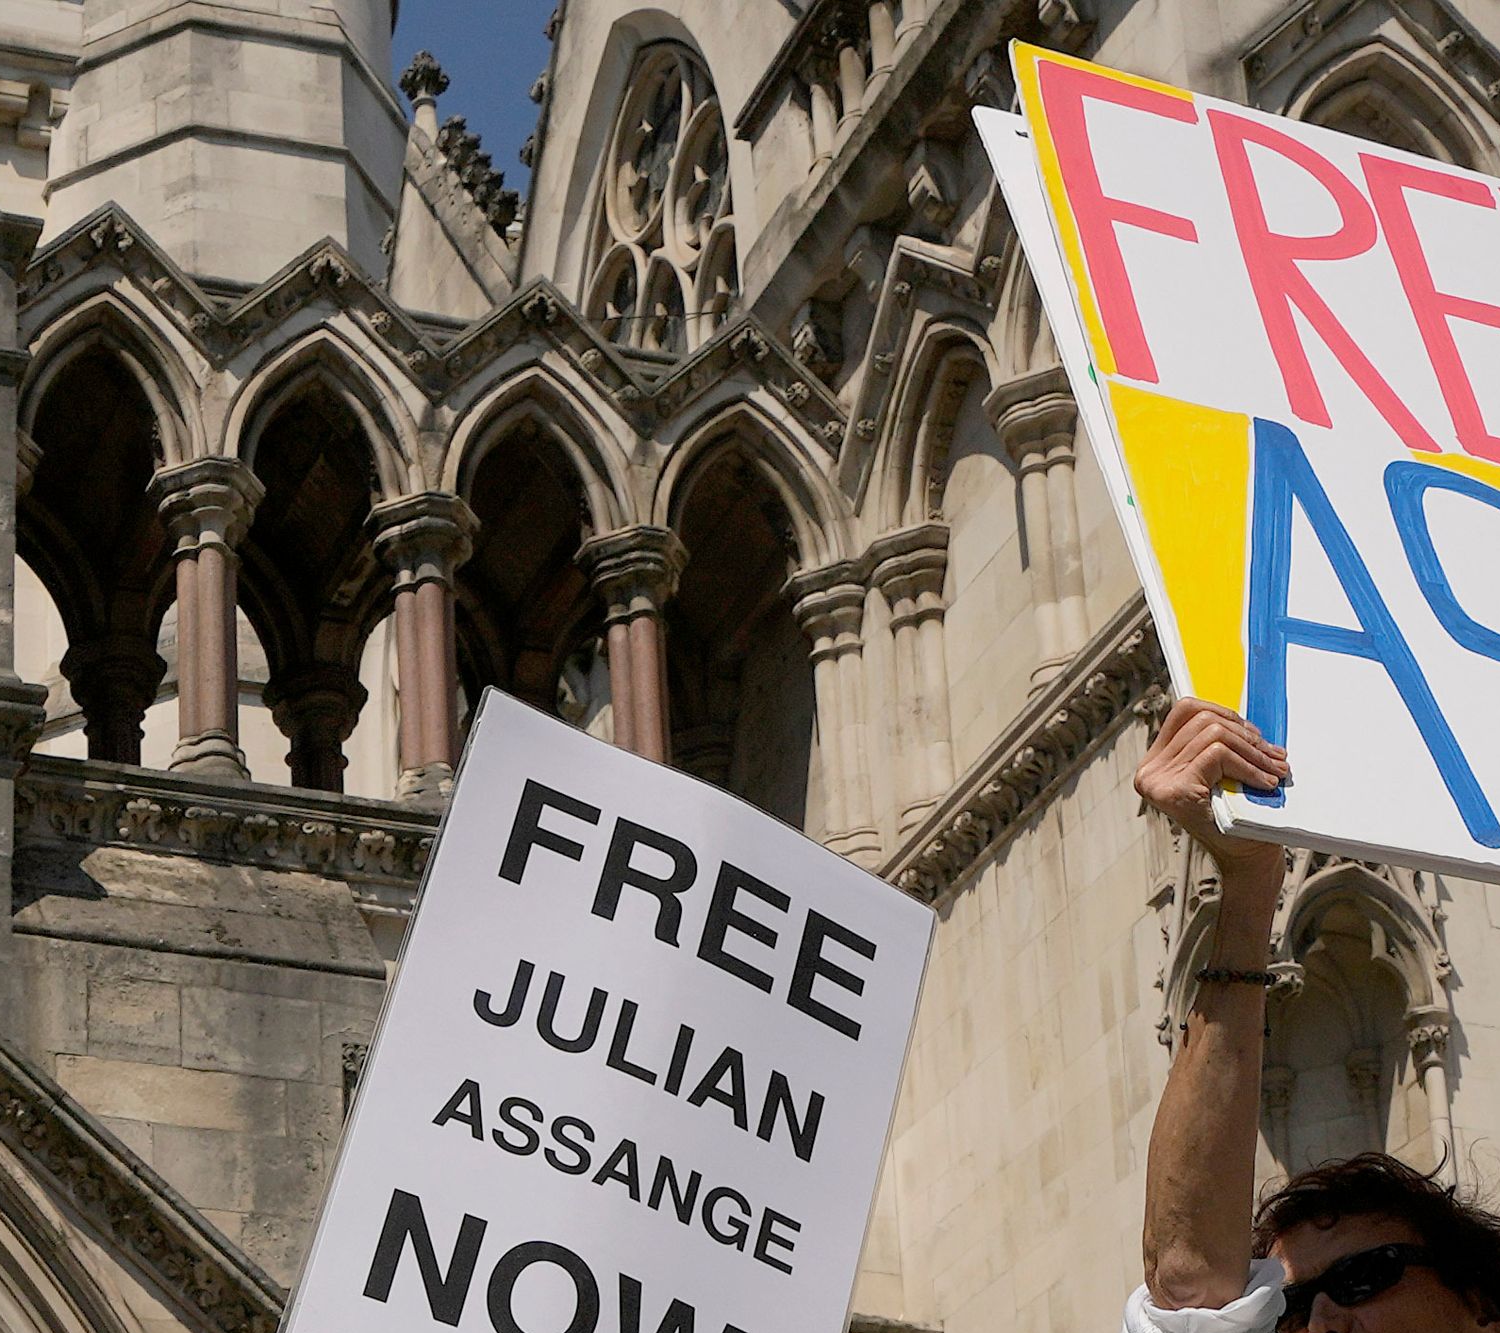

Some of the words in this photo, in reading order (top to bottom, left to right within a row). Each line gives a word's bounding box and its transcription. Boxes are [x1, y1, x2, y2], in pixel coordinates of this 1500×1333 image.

[498, 778, 877, 1041] FREE
[473, 959, 826, 1163] JULIAN
[432, 1078, 802, 1275] ASSANGE
